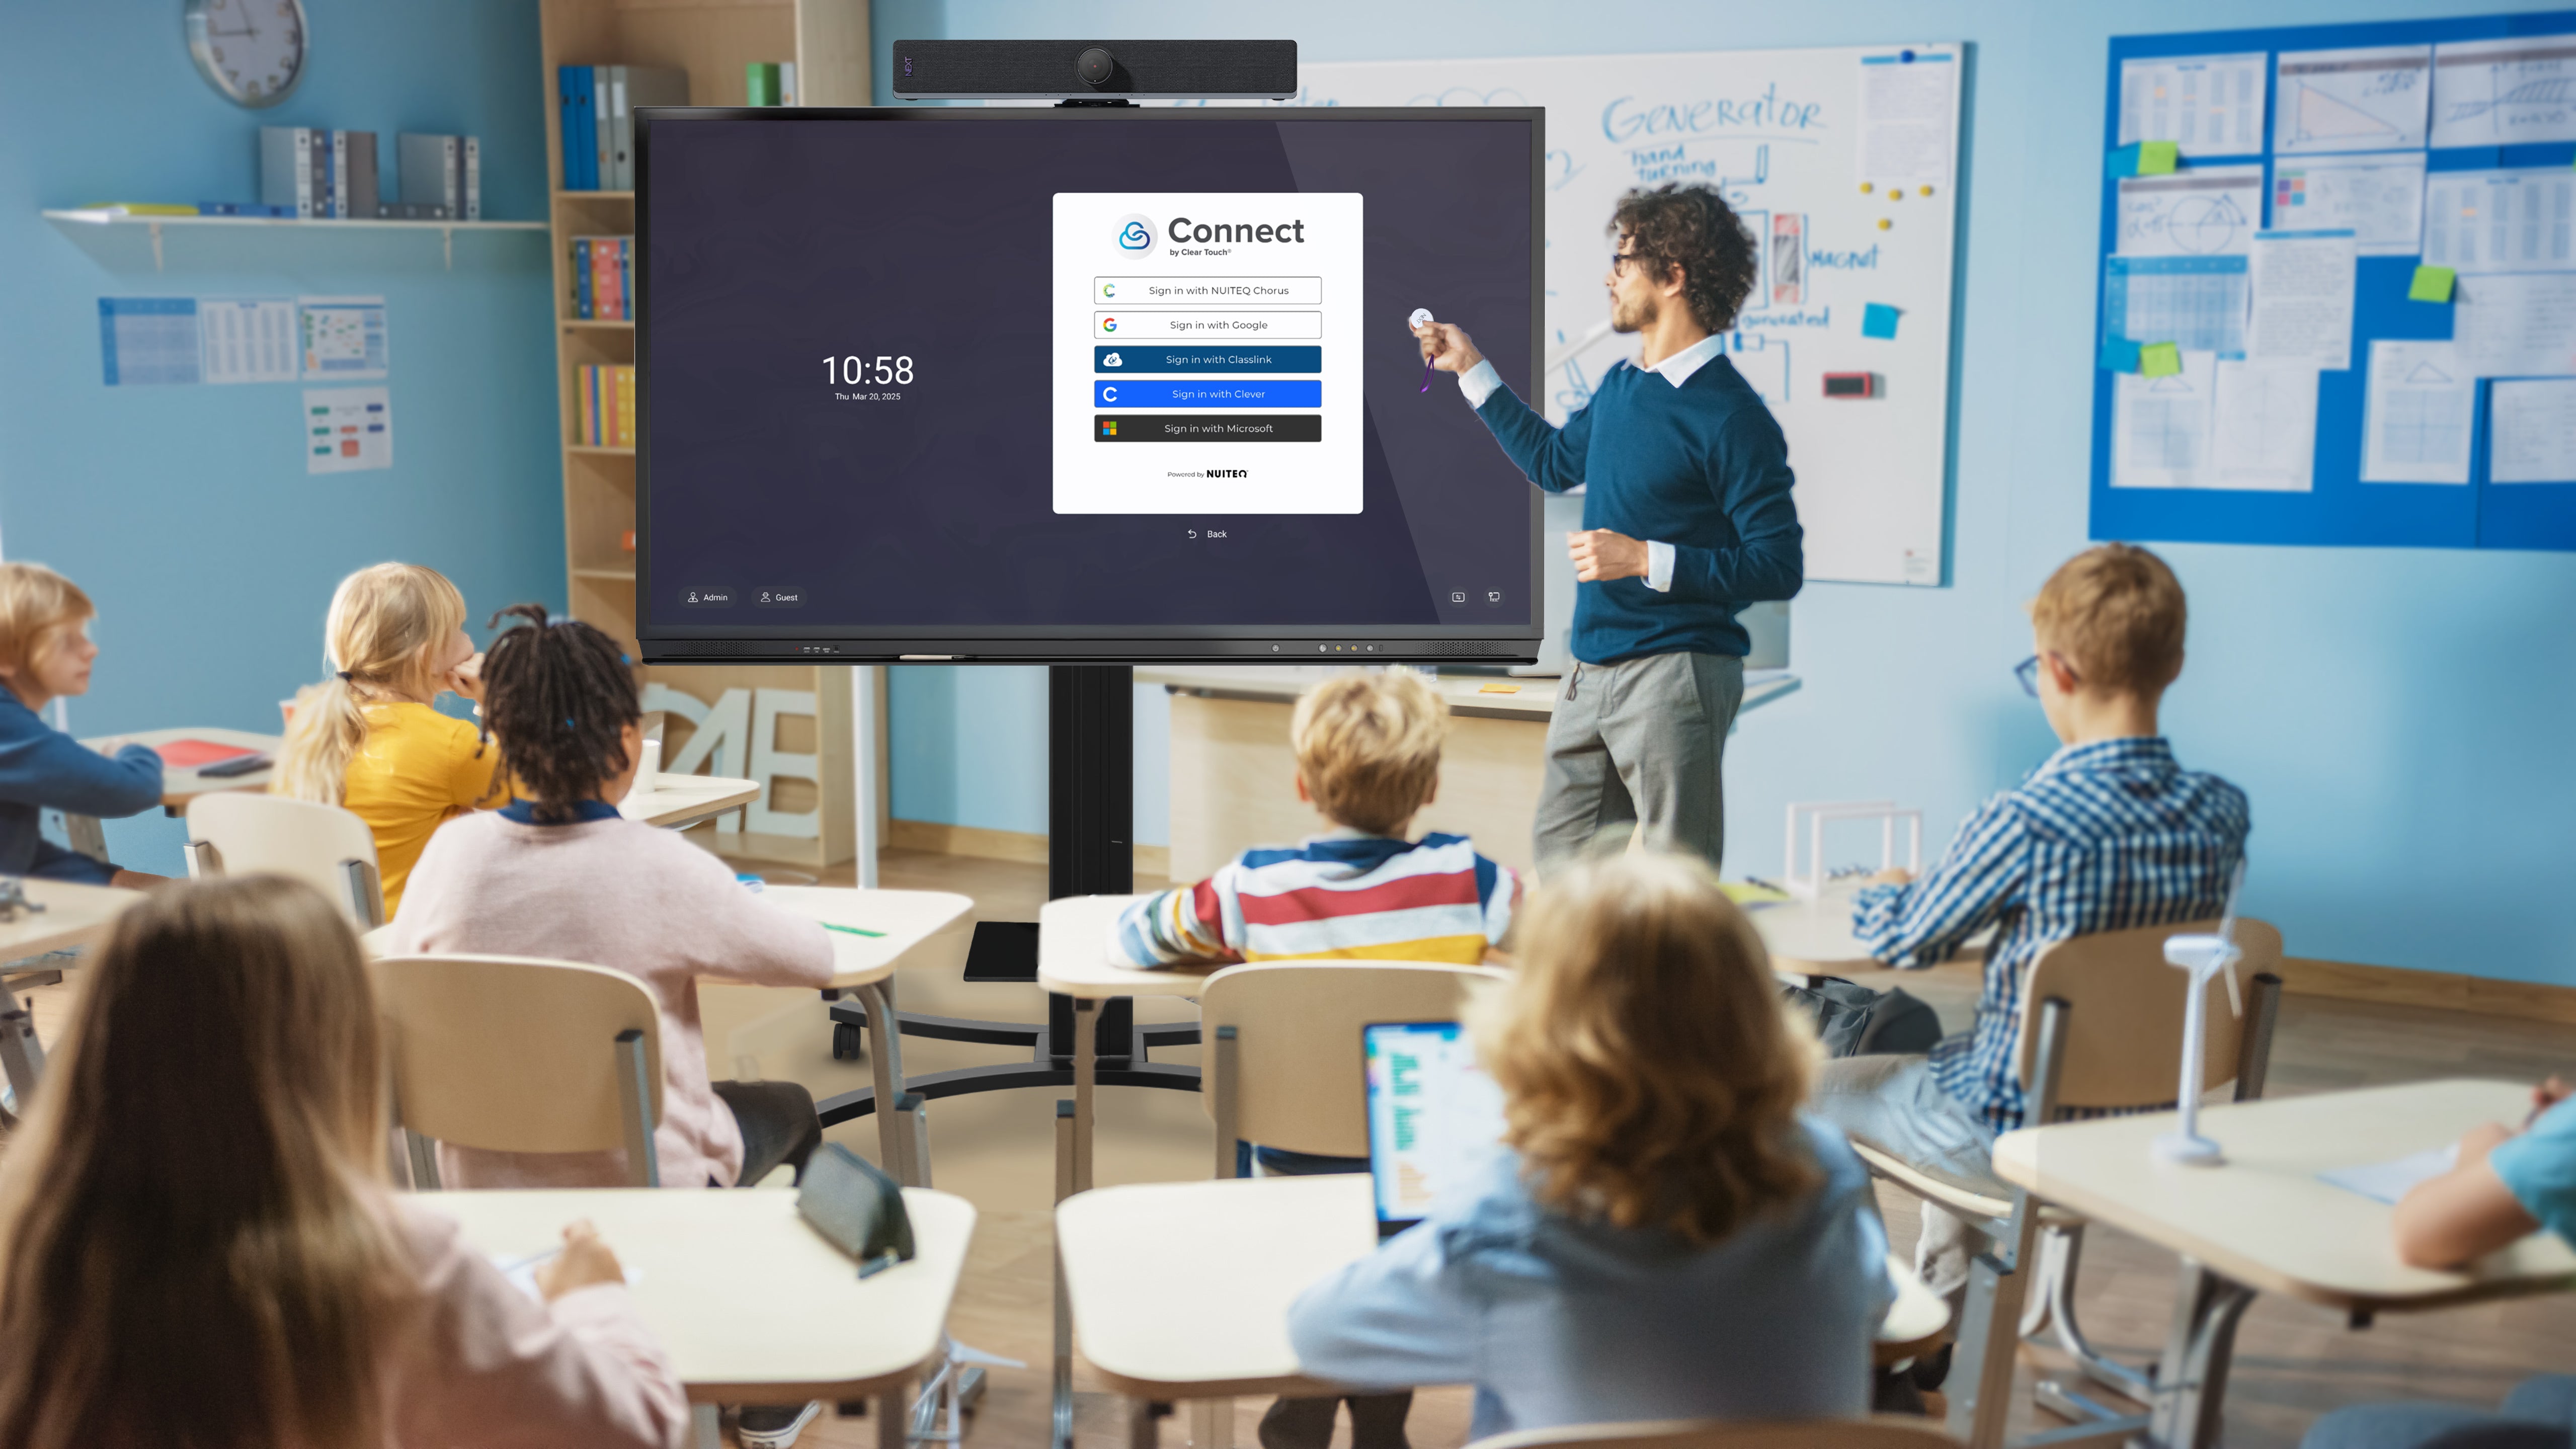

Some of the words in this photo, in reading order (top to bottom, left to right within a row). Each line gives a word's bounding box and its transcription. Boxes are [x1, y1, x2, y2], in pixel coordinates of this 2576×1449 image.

[1169, 217, 1304, 243] Connect
[1150, 287, 1171, 296] Sign
[1186, 286, 1208, 294] with
[1212, 287, 1250, 295] NUITEQ
[1171, 321, 1192, 331] Sign
[1208, 321, 1229, 329] with
[1233, 321, 1267, 331] Google
[1167, 356, 1188, 365] Sign
[1229, 355, 1271, 363] Classlink
[823, 356, 913, 384] 10:58
[1173, 390, 1194, 399] Sign
[1198, 390, 1206, 398] in
[1210, 390, 1231, 398] with
[1235, 390, 1265, 398] Clever
[1165, 425, 1186, 434] Sign
